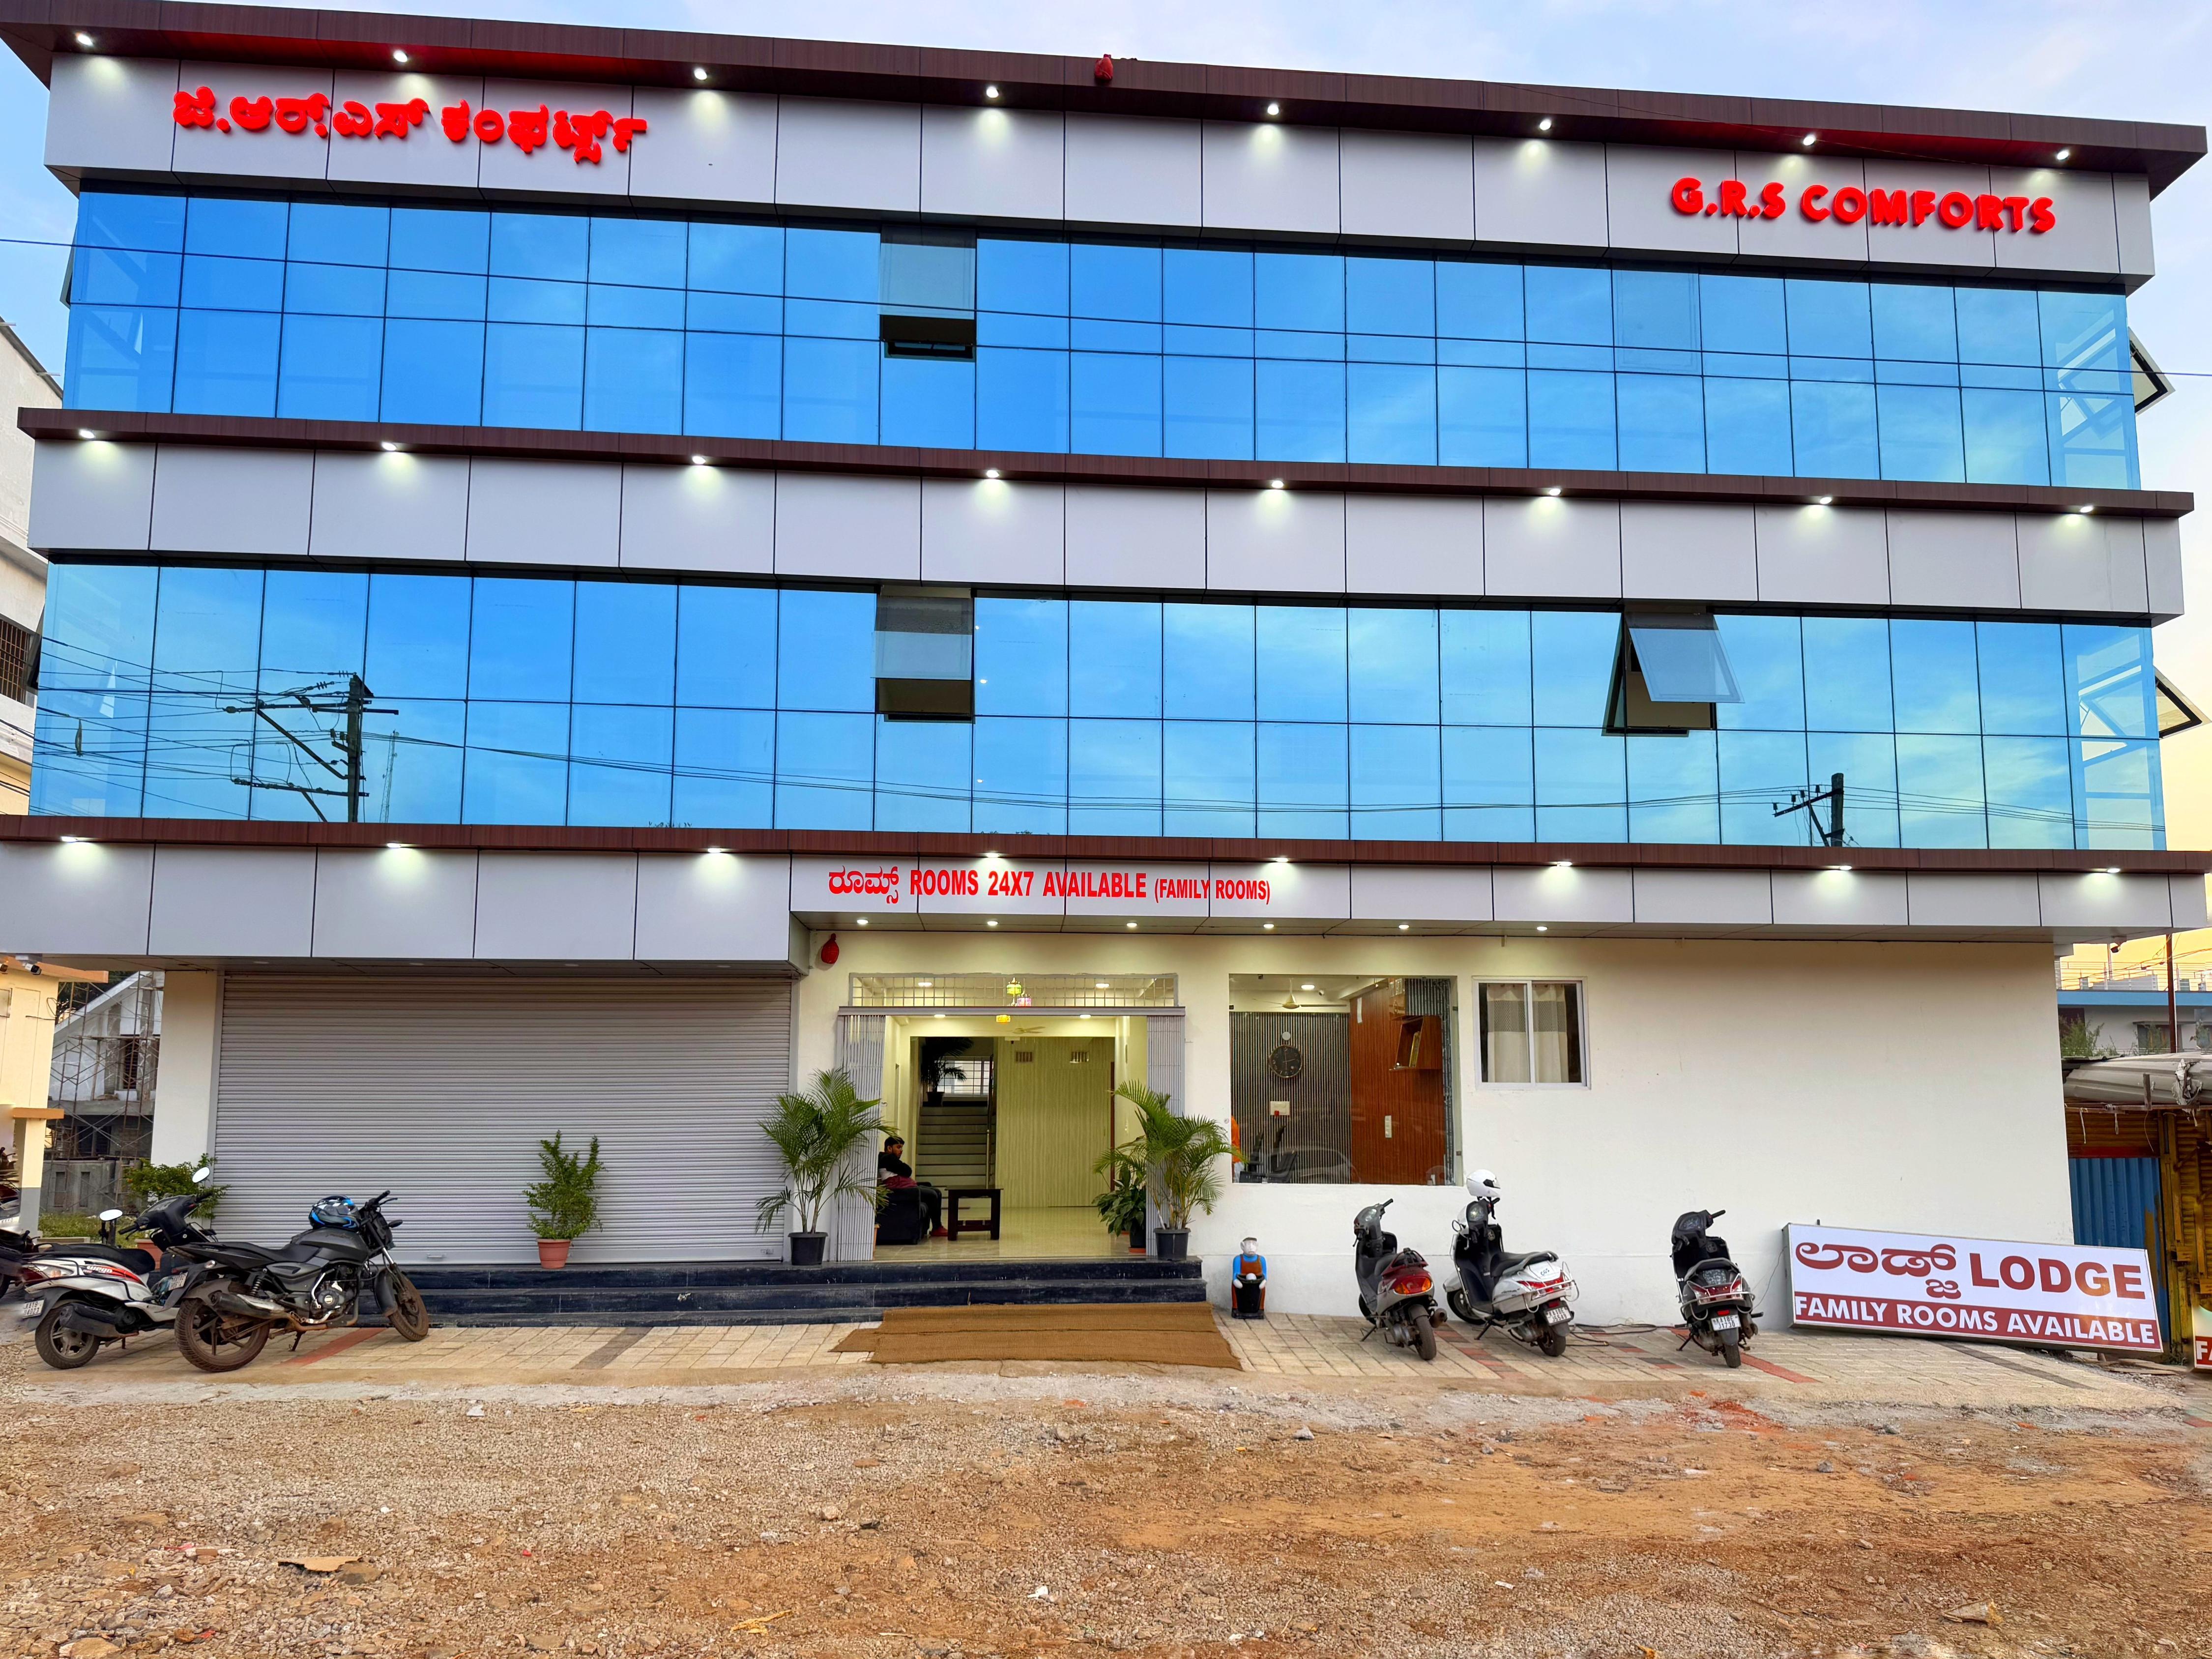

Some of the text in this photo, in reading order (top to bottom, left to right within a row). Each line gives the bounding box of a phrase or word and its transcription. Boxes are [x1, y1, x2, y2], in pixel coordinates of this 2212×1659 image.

[1671, 177, 2056, 234] G.R.S COMFORTS
[829, 865, 1270, 904] ರೂಮ್ಸ್ ROOMS 24X7 AVAILABLE (FAMILY ROOMS)
[1795, 1242, 2146, 1299] ಲಾಡ್ಜ್ LODGE
[1795, 1296, 2155, 1344] FAMILY ROOMS AVAILABLE
